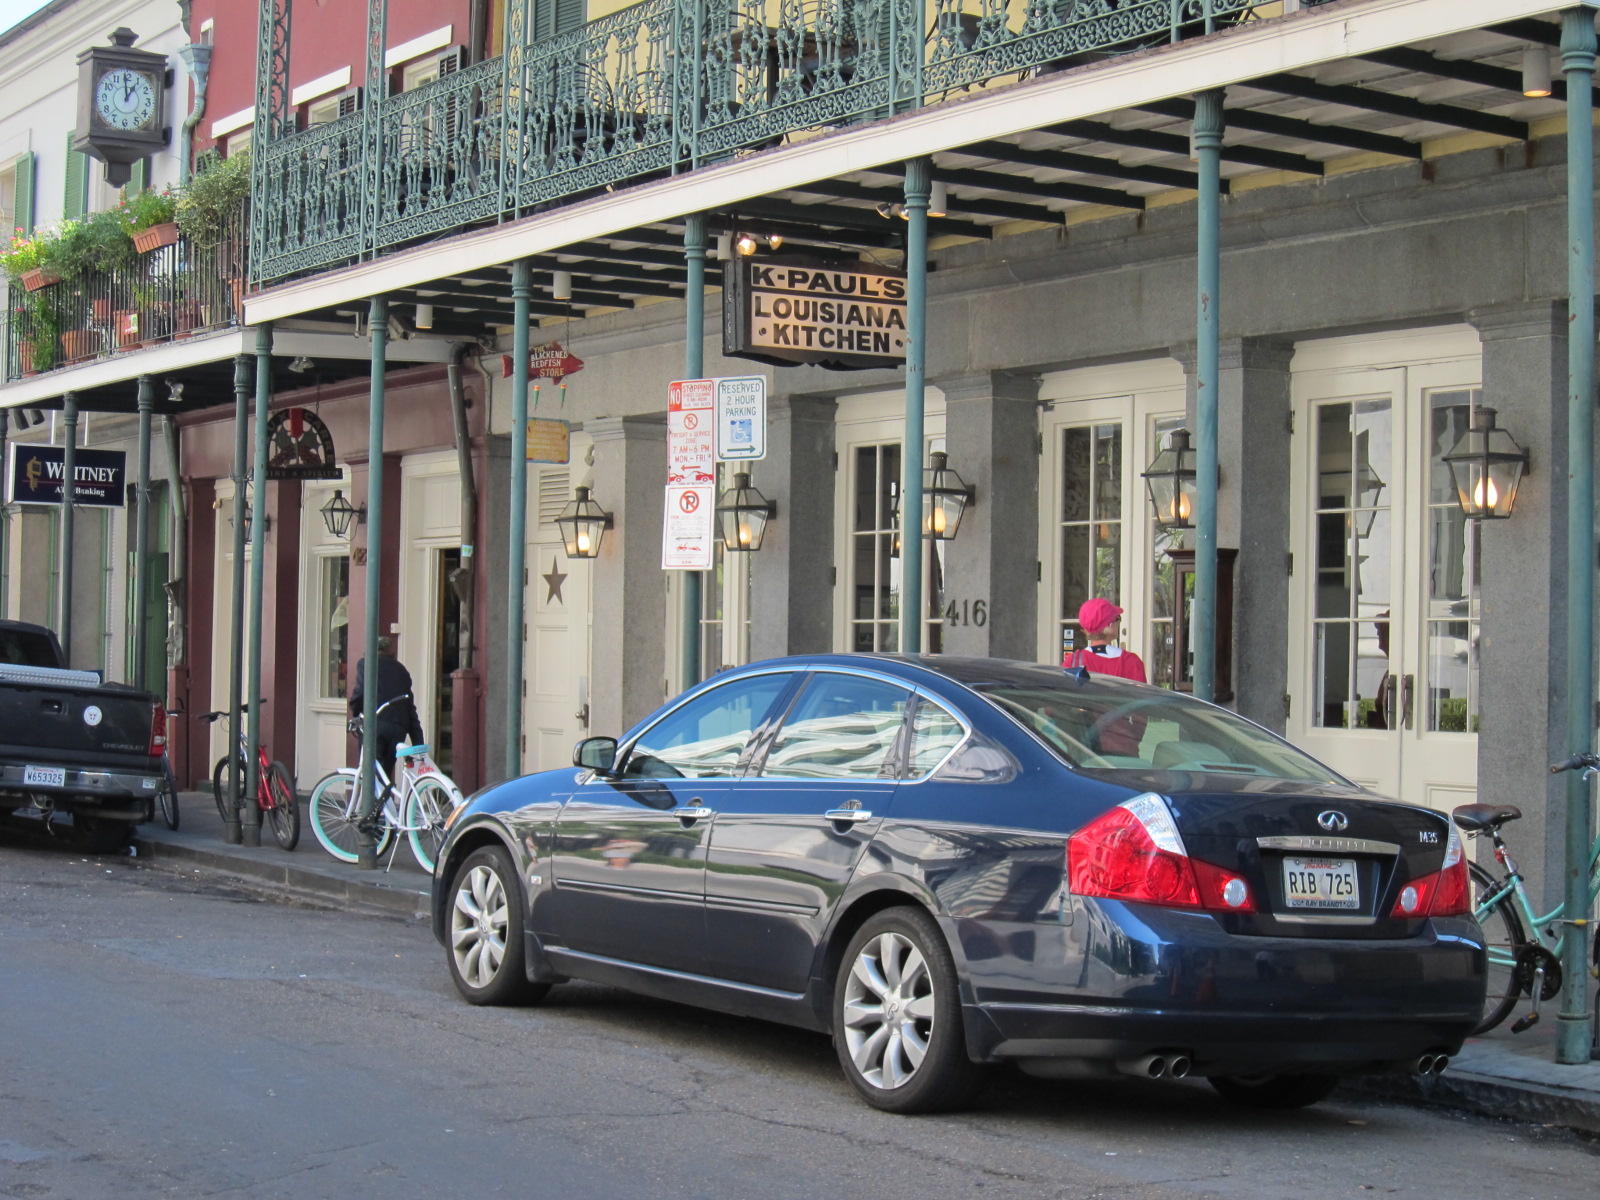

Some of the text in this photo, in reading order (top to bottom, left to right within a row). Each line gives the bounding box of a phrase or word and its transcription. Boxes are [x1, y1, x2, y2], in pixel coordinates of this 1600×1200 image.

[105, 82, 113, 91] 10
[136, 77, 140, 86] 1
[143, 87, 148, 95] 2
[102, 93, 107, 102] 9
[144, 98, 151, 107] 3
[103, 105, 109, 113] 8
[141, 109, 148, 118] 4
[112, 114, 117, 123] 7
[122, 119, 128, 127] 6
[133, 117, 140, 126] 5
[752, 266, 905, 299] K-PAUL'S
[754, 295, 906, 330] LOUISIANA
[773, 323, 890, 353] KITCHEN
[534, 345, 545, 353] THE
[531, 350, 568, 362] BLACKENED
[531, 359, 561, 369] REDFISH
[540, 368, 565, 377] STORE
[682, 383, 712, 393] STOPPING
[721, 383, 760, 394] RESERVED
[670, 389, 681, 405] NO
[726, 395, 755, 406] 2 HOUR
[726, 407, 757, 417] PARKING
[673, 446, 677, 454] 7
[701, 444, 710, 452] PM
[45, 461, 115, 482] WITNEY
[75, 487, 105, 497] Banking
[945, 599, 987, 627] 416
[102, 742, 145, 751] CHEVROLET
[27, 771, 63, 784] W653325
[1419, 831, 1438, 843] M35
[1289, 871, 1353, 895] RIB 725
